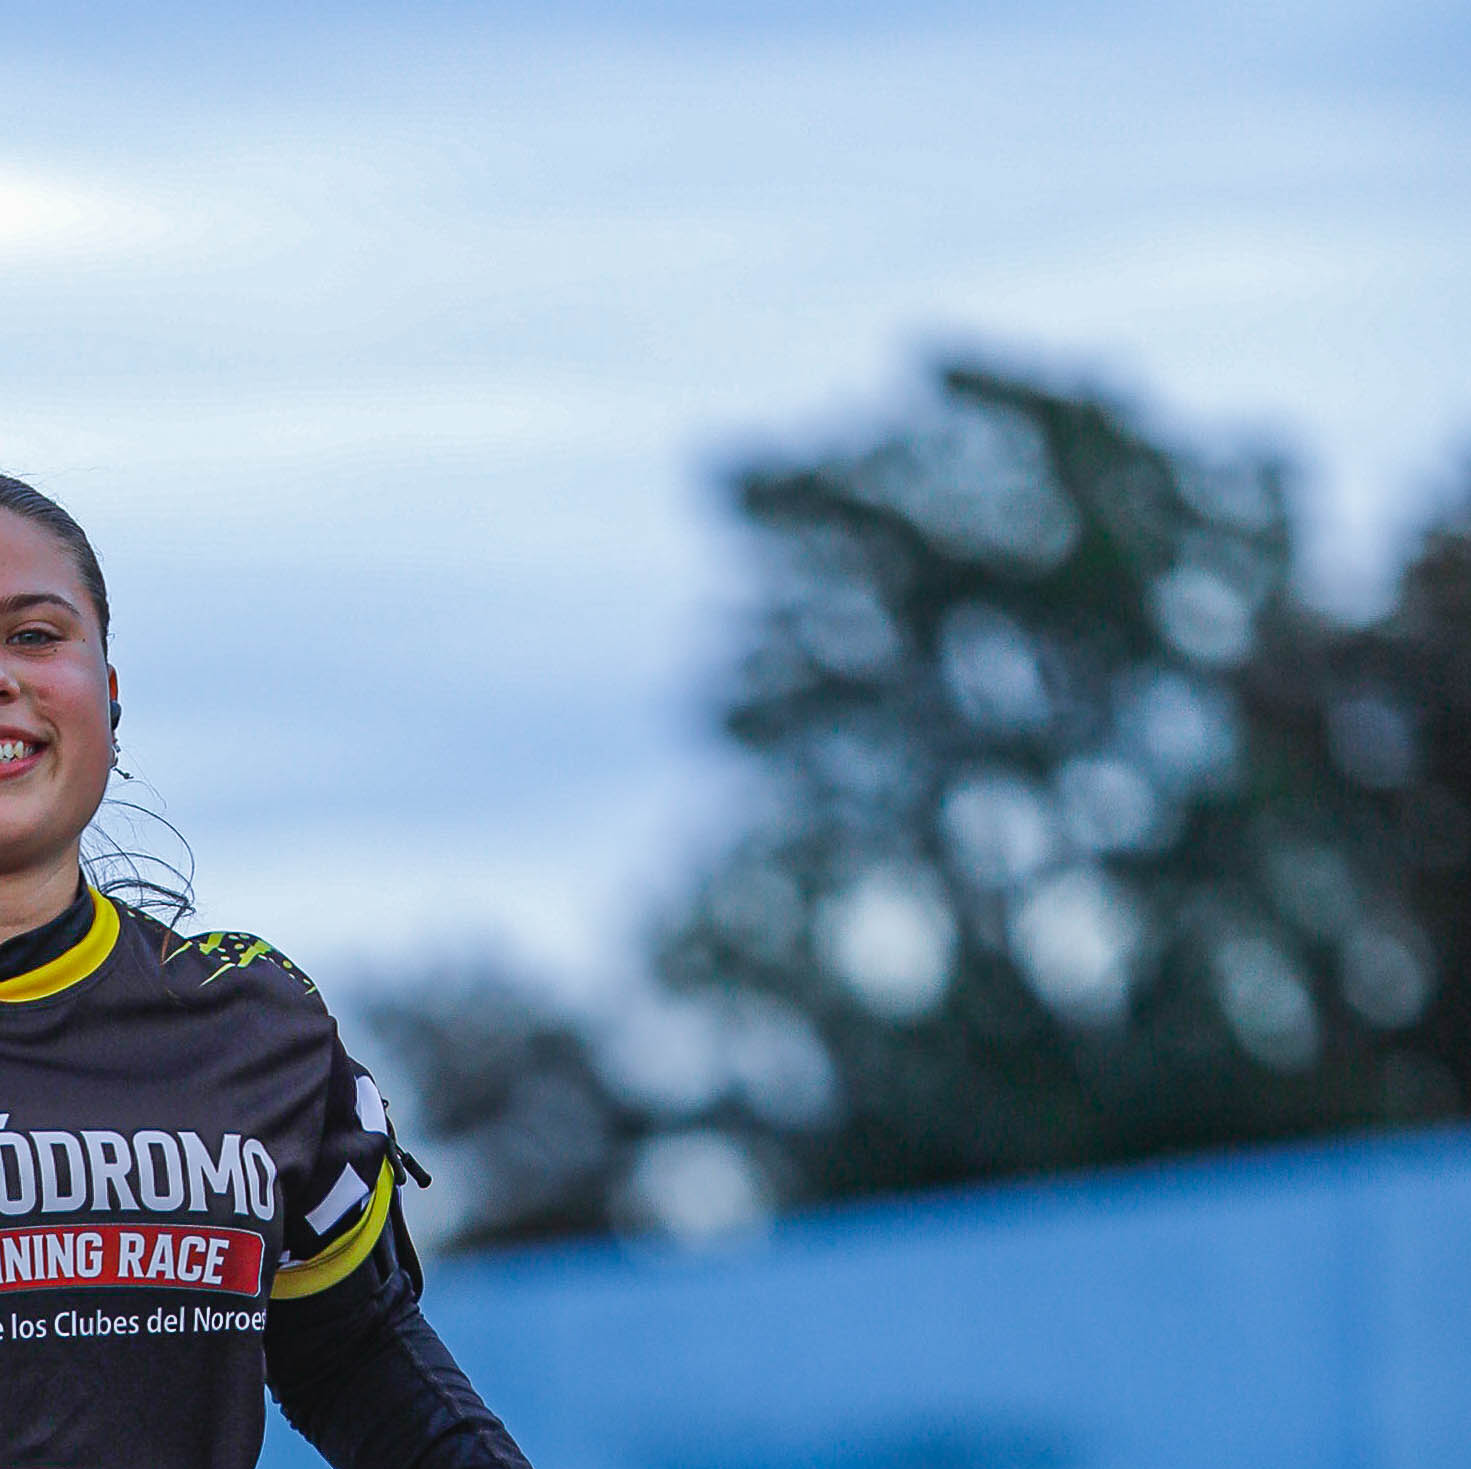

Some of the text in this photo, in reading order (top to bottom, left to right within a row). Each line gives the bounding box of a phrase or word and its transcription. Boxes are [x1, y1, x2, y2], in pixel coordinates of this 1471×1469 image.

[118, 1232, 230, 1285] RACE
[12, 1313, 47, 1339] los
[54, 1310, 139, 1337] Clubes
[147, 1306, 185, 1333] del
